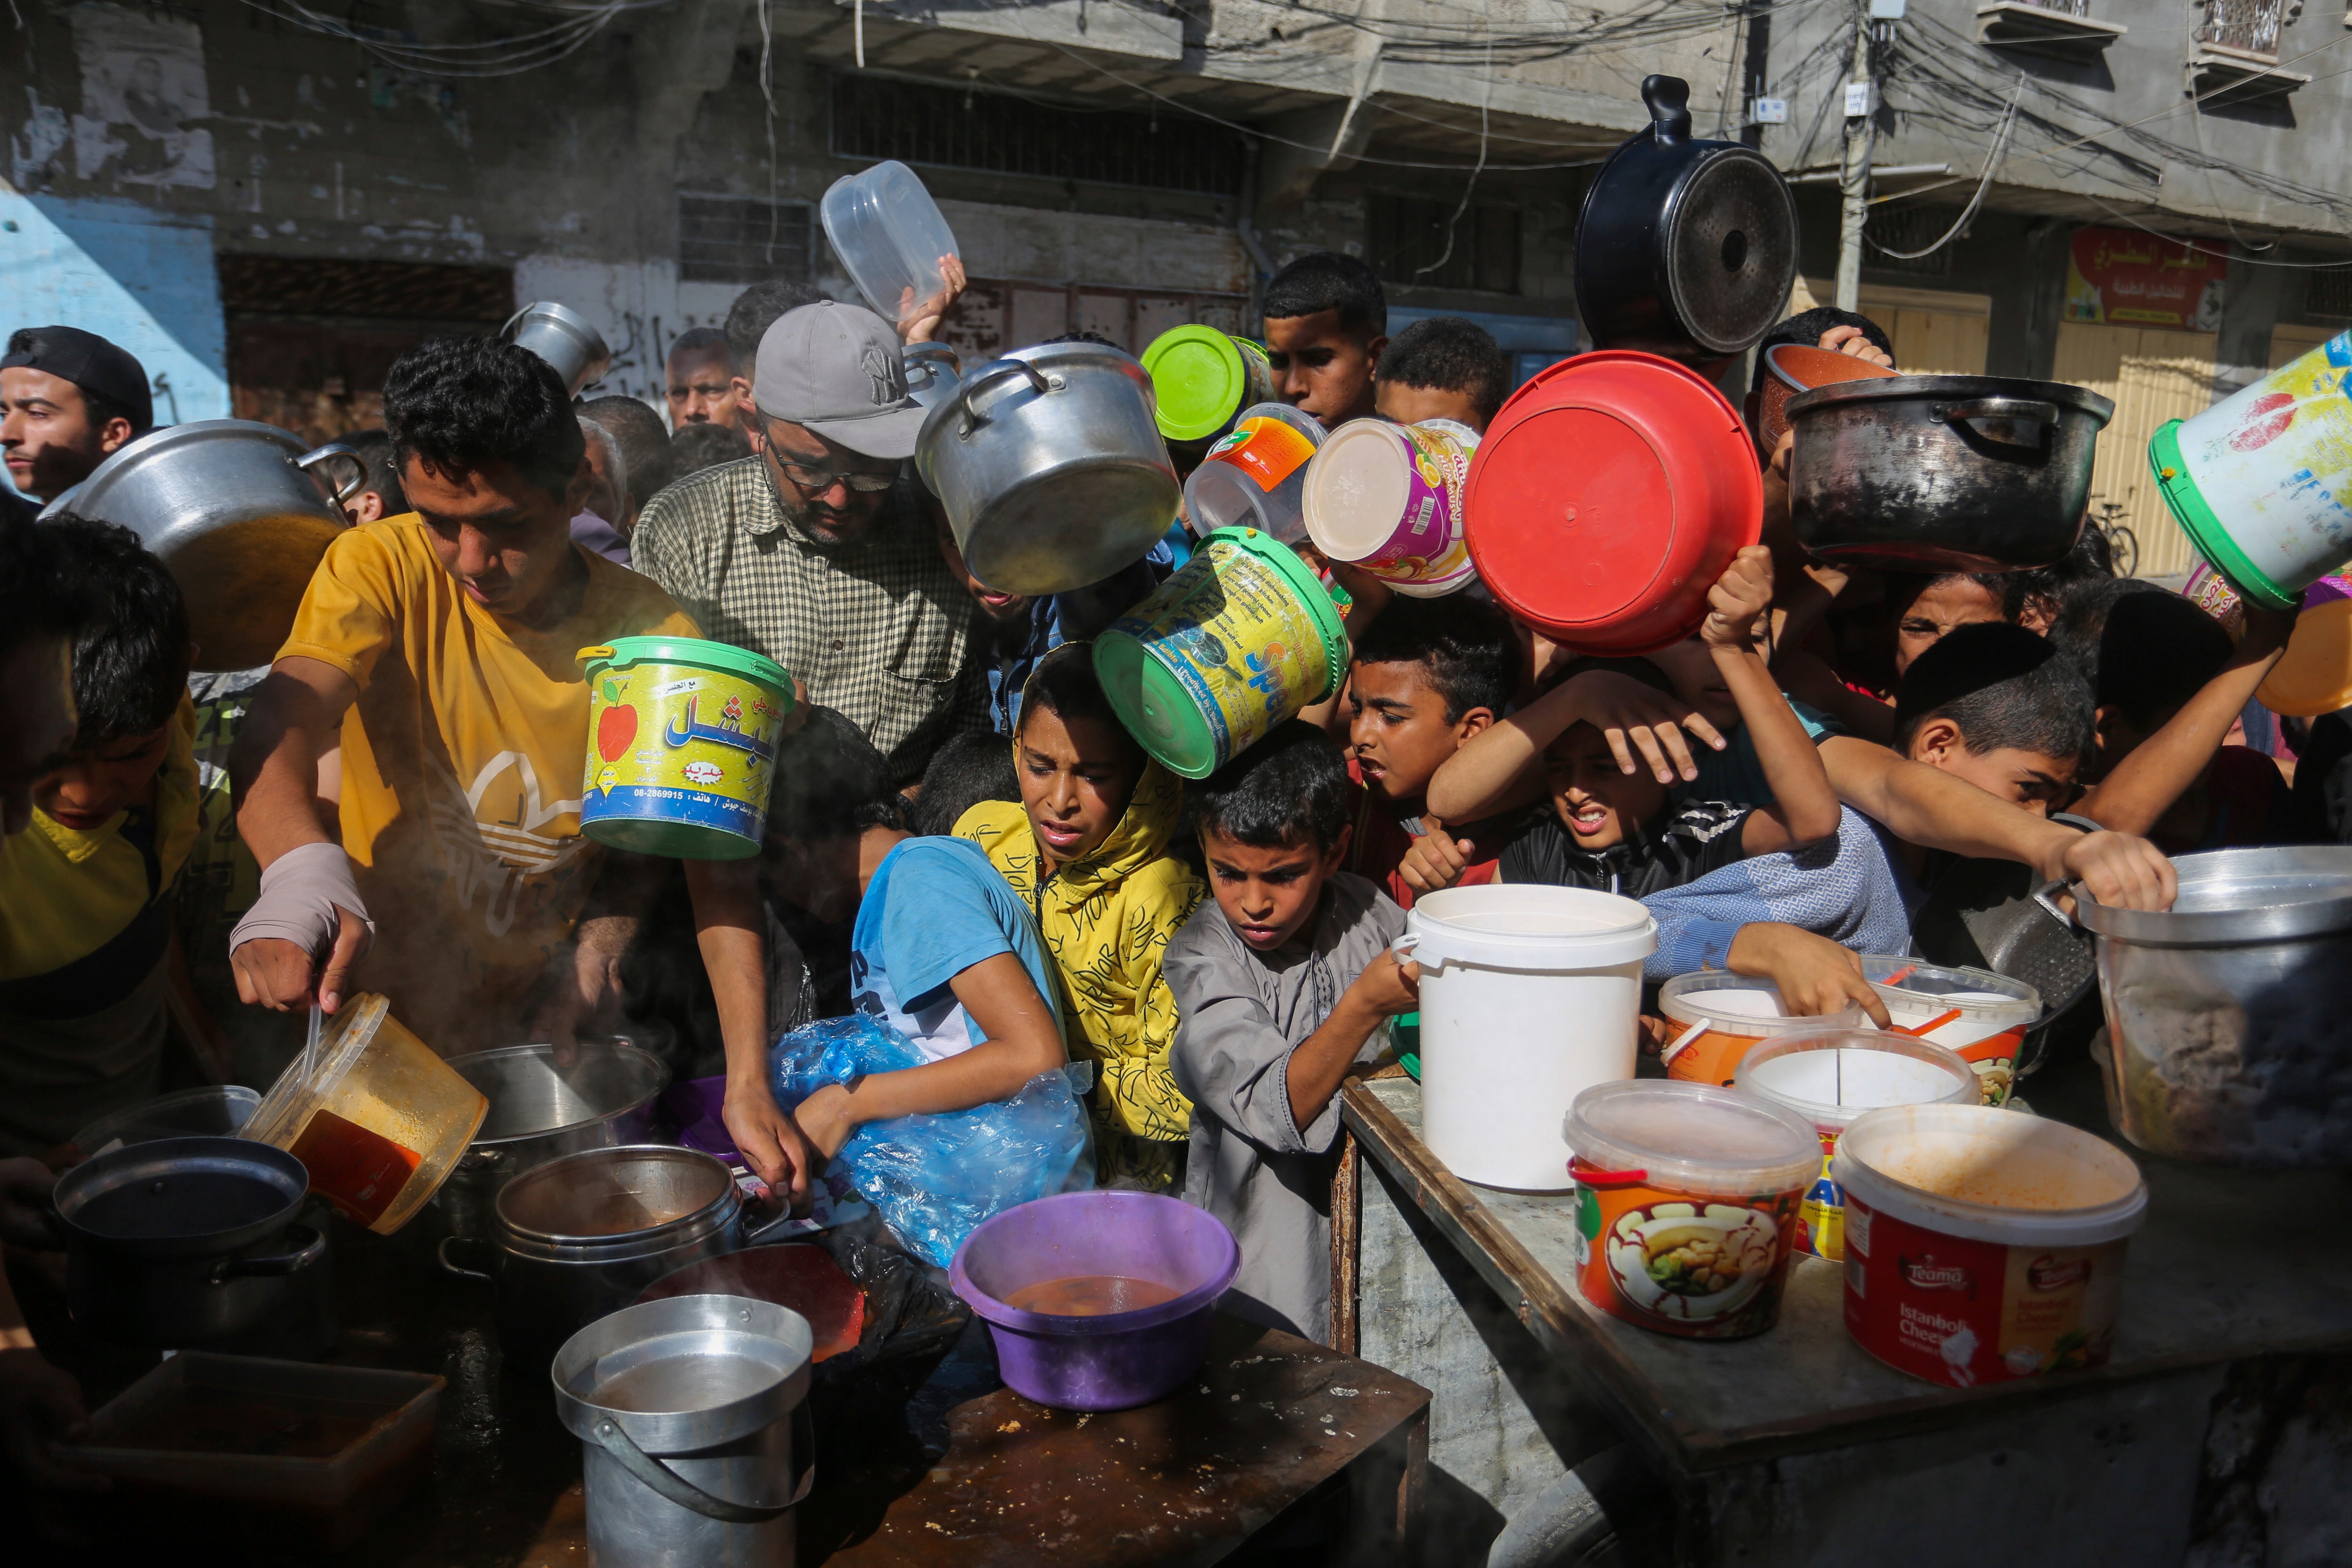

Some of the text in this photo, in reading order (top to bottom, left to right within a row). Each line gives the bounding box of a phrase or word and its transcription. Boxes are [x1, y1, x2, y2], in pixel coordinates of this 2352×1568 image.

[1438, 454, 1456, 509] HUMMUS
[1224, 575, 1235, 583] ware
[1242, 589, 1259, 603] general
[1248, 580, 1259, 589] clean
[1259, 589, 1274, 605] kitchen
[1252, 570, 1266, 582] strong
[1265, 581, 1289, 607] dishwashing
[1224, 587, 1236, 597] tough
[1255, 615, 1264, 624] soft
[1214, 619, 1228, 633] hands
[1227, 632, 1236, 642] soft
[1234, 641, 1243, 650] and
[1158, 643, 1178, 663] Edible
[680, 765, 725, 782] جديد
[634, 788, 683, 800] 08-2869915
[692, 792, 711, 803] هاتف
[1814, 1211, 1838, 1221] Lemon
[1907, 1264, 1963, 1283] Teama
[1900, 1302, 1968, 1334] Istanboli
